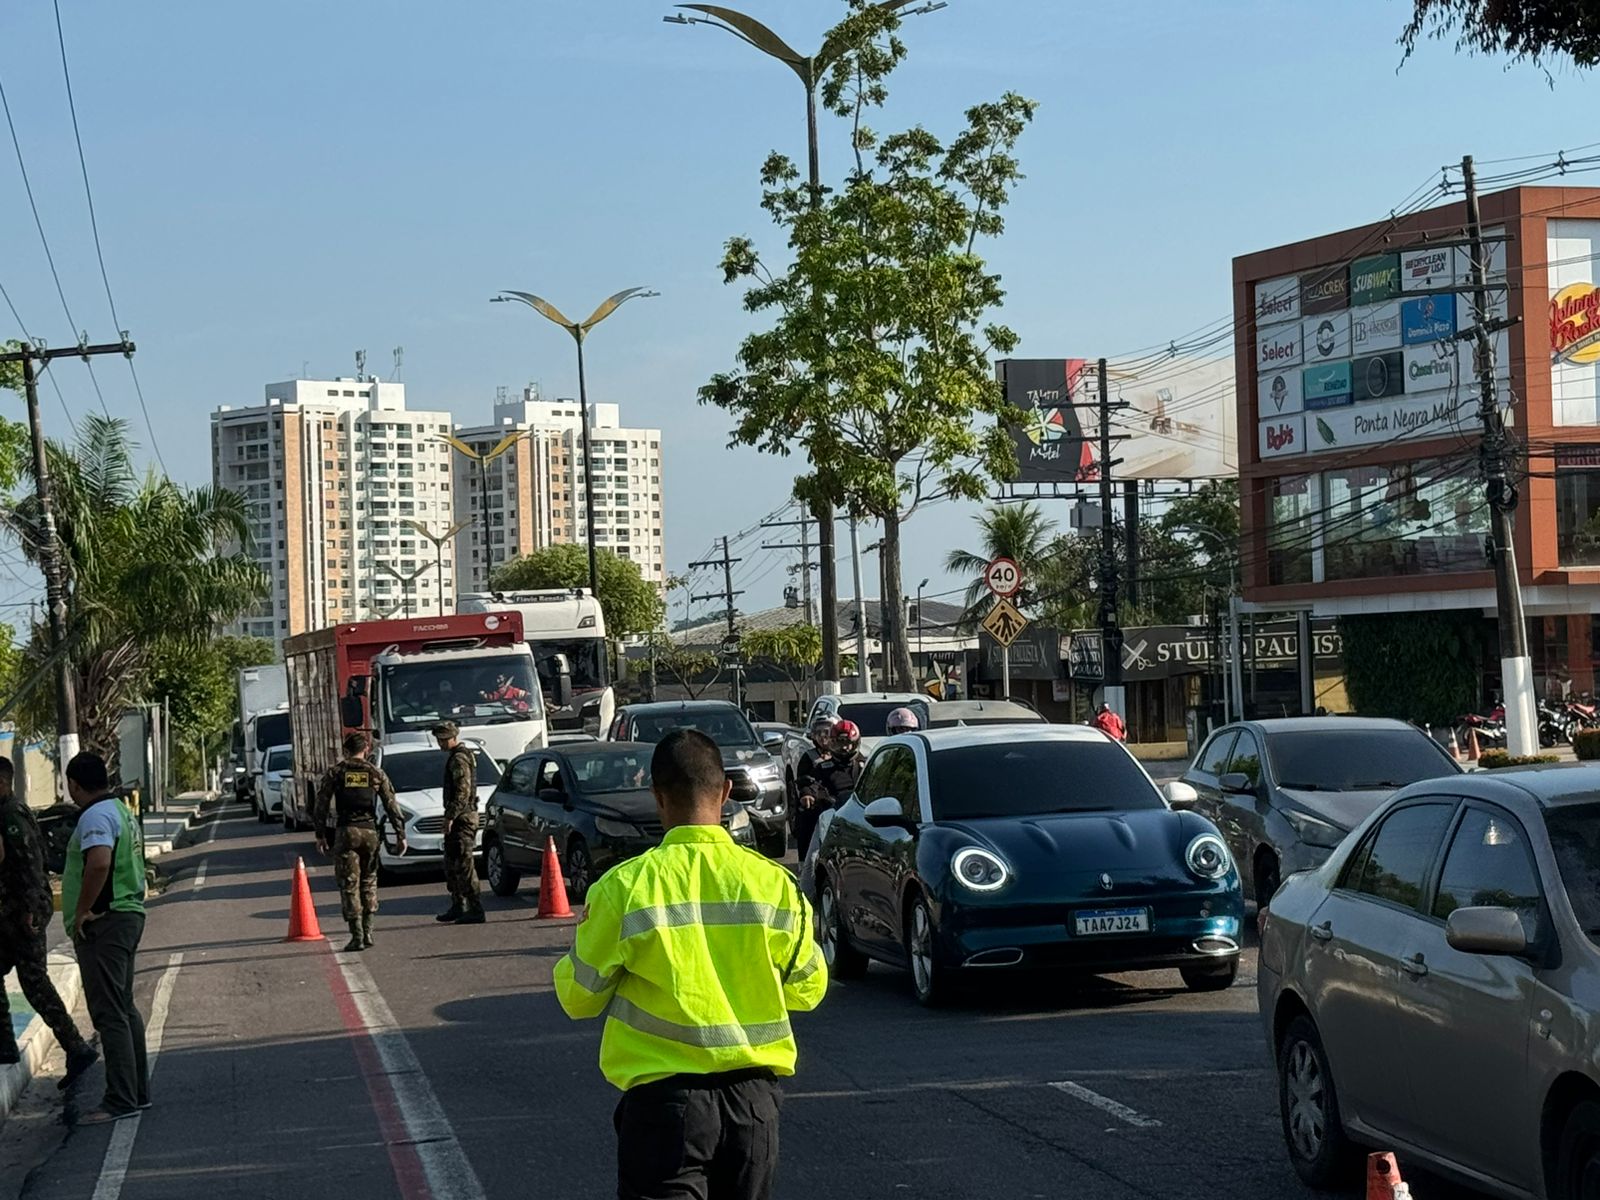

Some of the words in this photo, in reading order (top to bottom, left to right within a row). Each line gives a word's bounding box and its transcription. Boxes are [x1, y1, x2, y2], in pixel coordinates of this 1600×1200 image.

[1431, 262, 1446, 274] USA
[1353, 268, 1396, 293] SUBWAY
[1262, 341, 1294, 361] Select
[1354, 412, 1389, 435] Ponta
[1393, 408, 1429, 432] Negra
[1266, 423, 1294, 451] Bob's
[991, 568, 1014, 582] 40
[929, 652, 955, 661] TAHITI
[1082, 916, 1140, 932] TAA7J24
